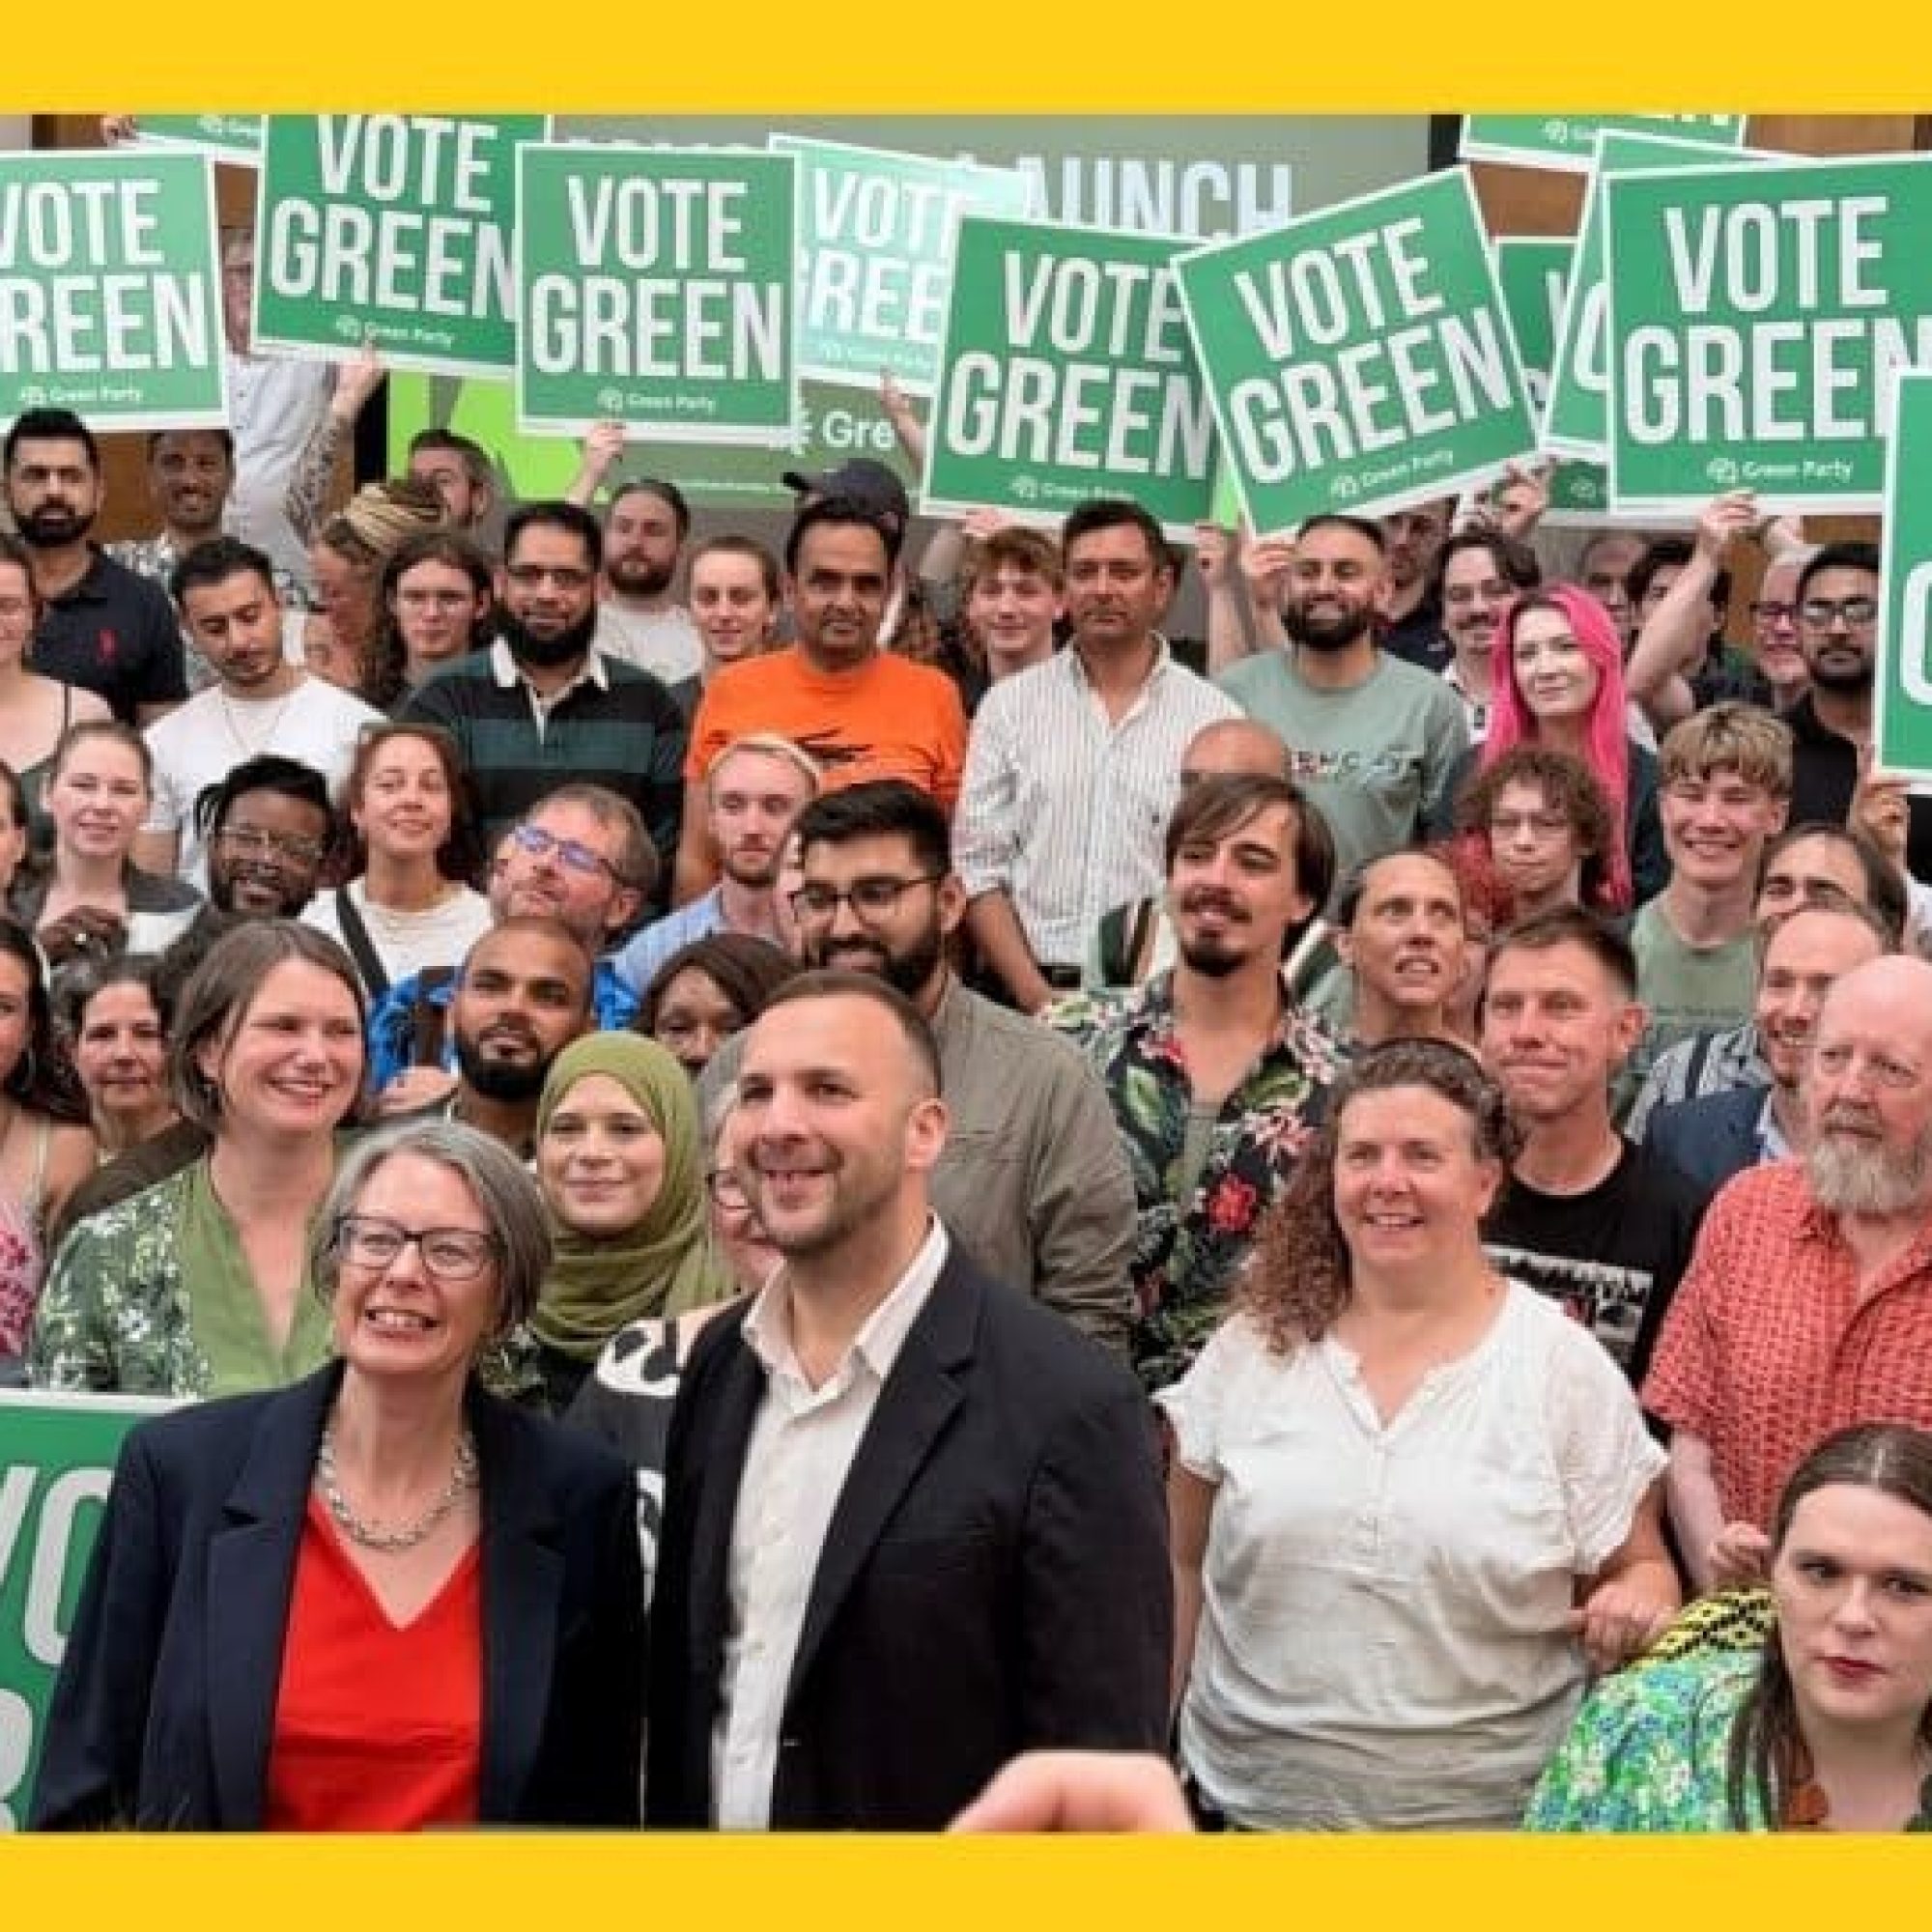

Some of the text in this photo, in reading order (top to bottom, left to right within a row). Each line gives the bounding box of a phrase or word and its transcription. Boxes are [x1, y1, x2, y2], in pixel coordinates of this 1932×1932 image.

[317, 114, 497, 212] VOTE
[1017, 156, 1293, 242] AUNCH
[270, 199, 516, 323] GREEN
[566, 175, 748, 272] VOTE
[1662, 196, 1889, 312] VOTE
[0, 271, 209, 373] REEN
[530, 274, 783, 380] GREEN
[809, 249, 946, 342] REE
[1005, 249, 1182, 361] VOTE
[1234, 217, 1444, 361] VOTE
[822, 411, 896, 451] Gre
[945, 351, 1215, 478] GREEN
[1230, 306, 1516, 484] GREEN
